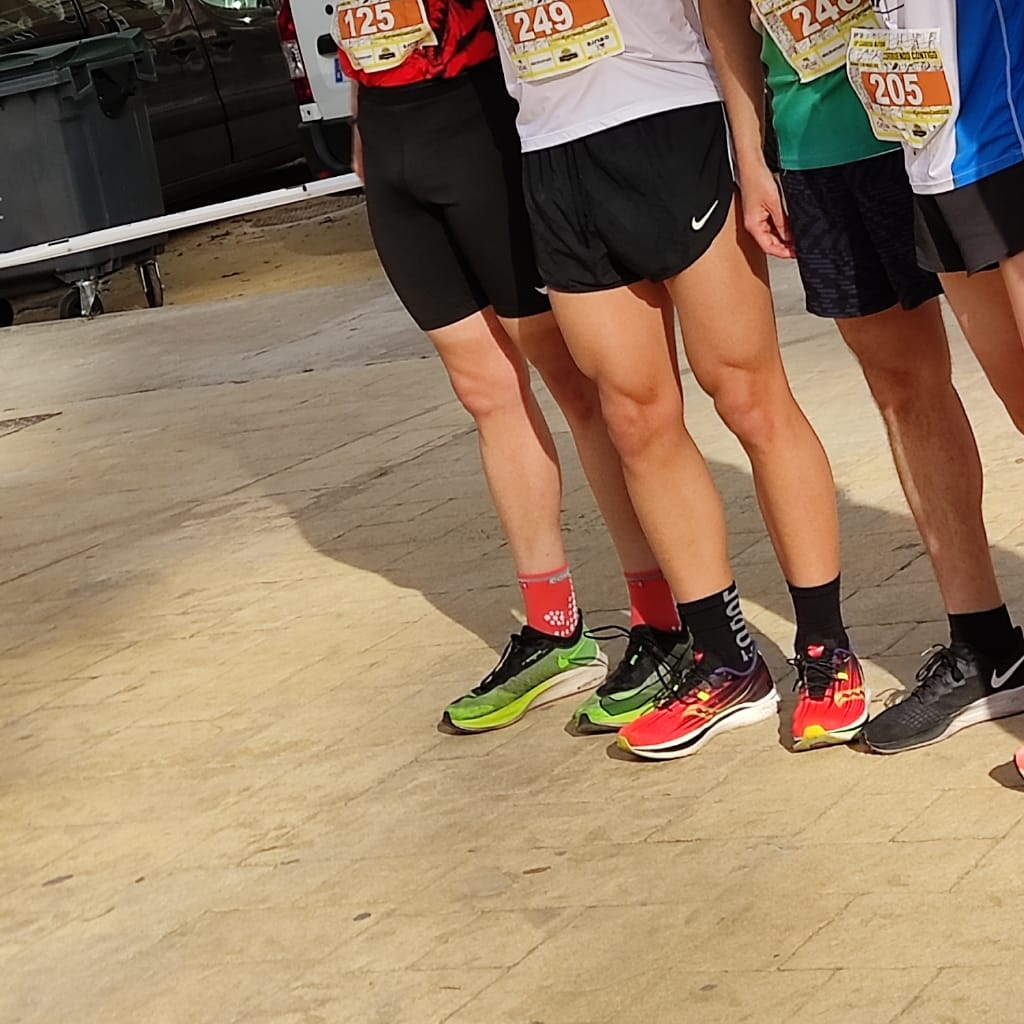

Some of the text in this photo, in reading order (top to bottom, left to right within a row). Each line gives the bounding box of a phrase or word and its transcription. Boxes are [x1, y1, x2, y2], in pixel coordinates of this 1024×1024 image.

[344, 3, 395, 37] 125
[514, 1, 574, 41] 249
[869, 73, 923, 106] 205
